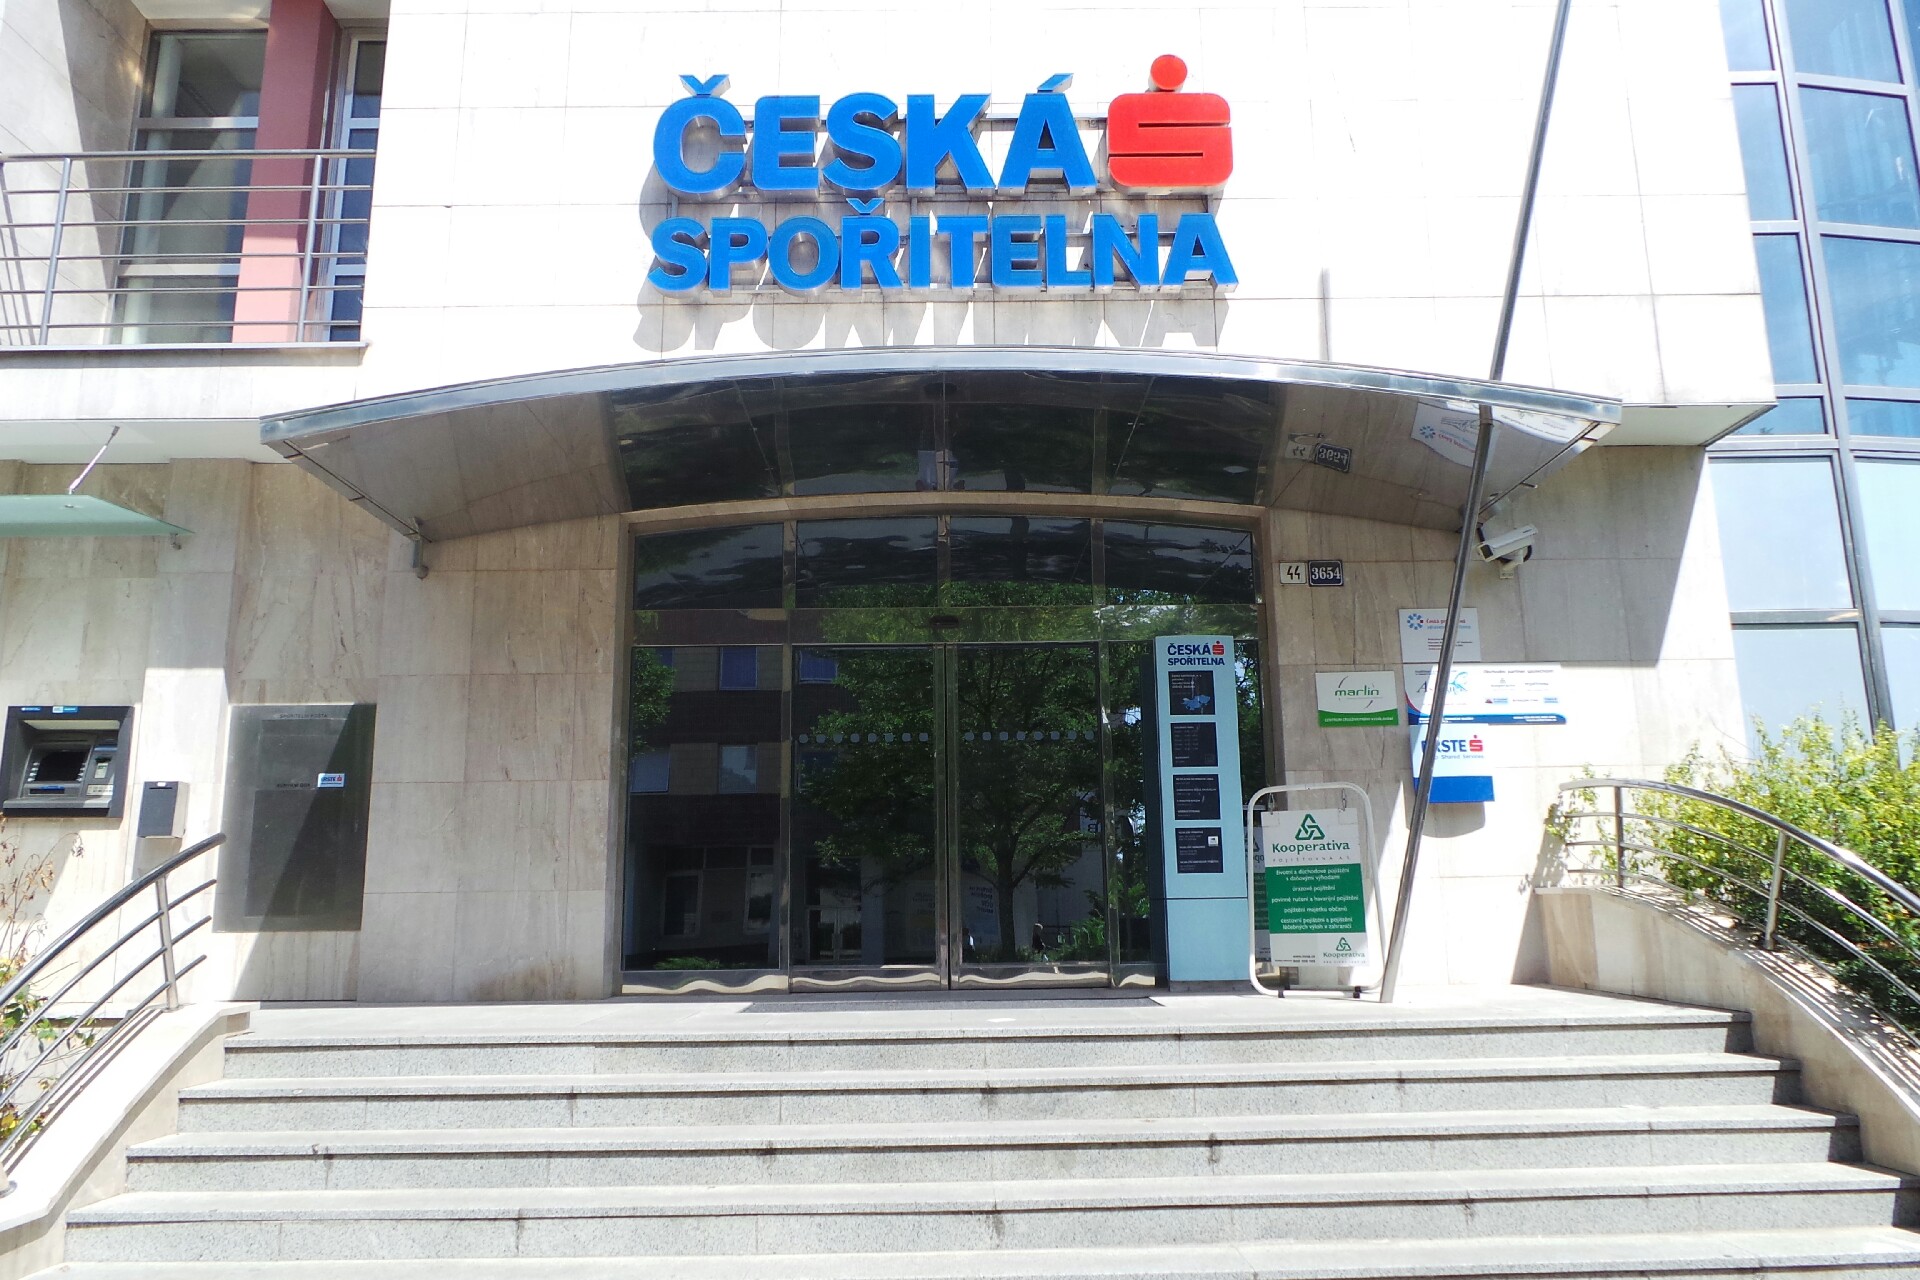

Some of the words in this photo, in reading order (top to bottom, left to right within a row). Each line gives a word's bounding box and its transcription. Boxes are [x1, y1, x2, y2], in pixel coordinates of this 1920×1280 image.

[653, 73, 1098, 196] ČESKÁ
[647, 198, 1239, 296] SPOŘITELNA
[1286, 563, 1301, 580] 44
[1311, 563, 1341, 580] 3654
[1167, 642, 1211, 656] ČESKÁ
[1167, 656, 1225, 666] SPOŘITELNA
[1334, 685, 1380, 696] marlin
[1272, 840, 1351, 855] Kooperativa
